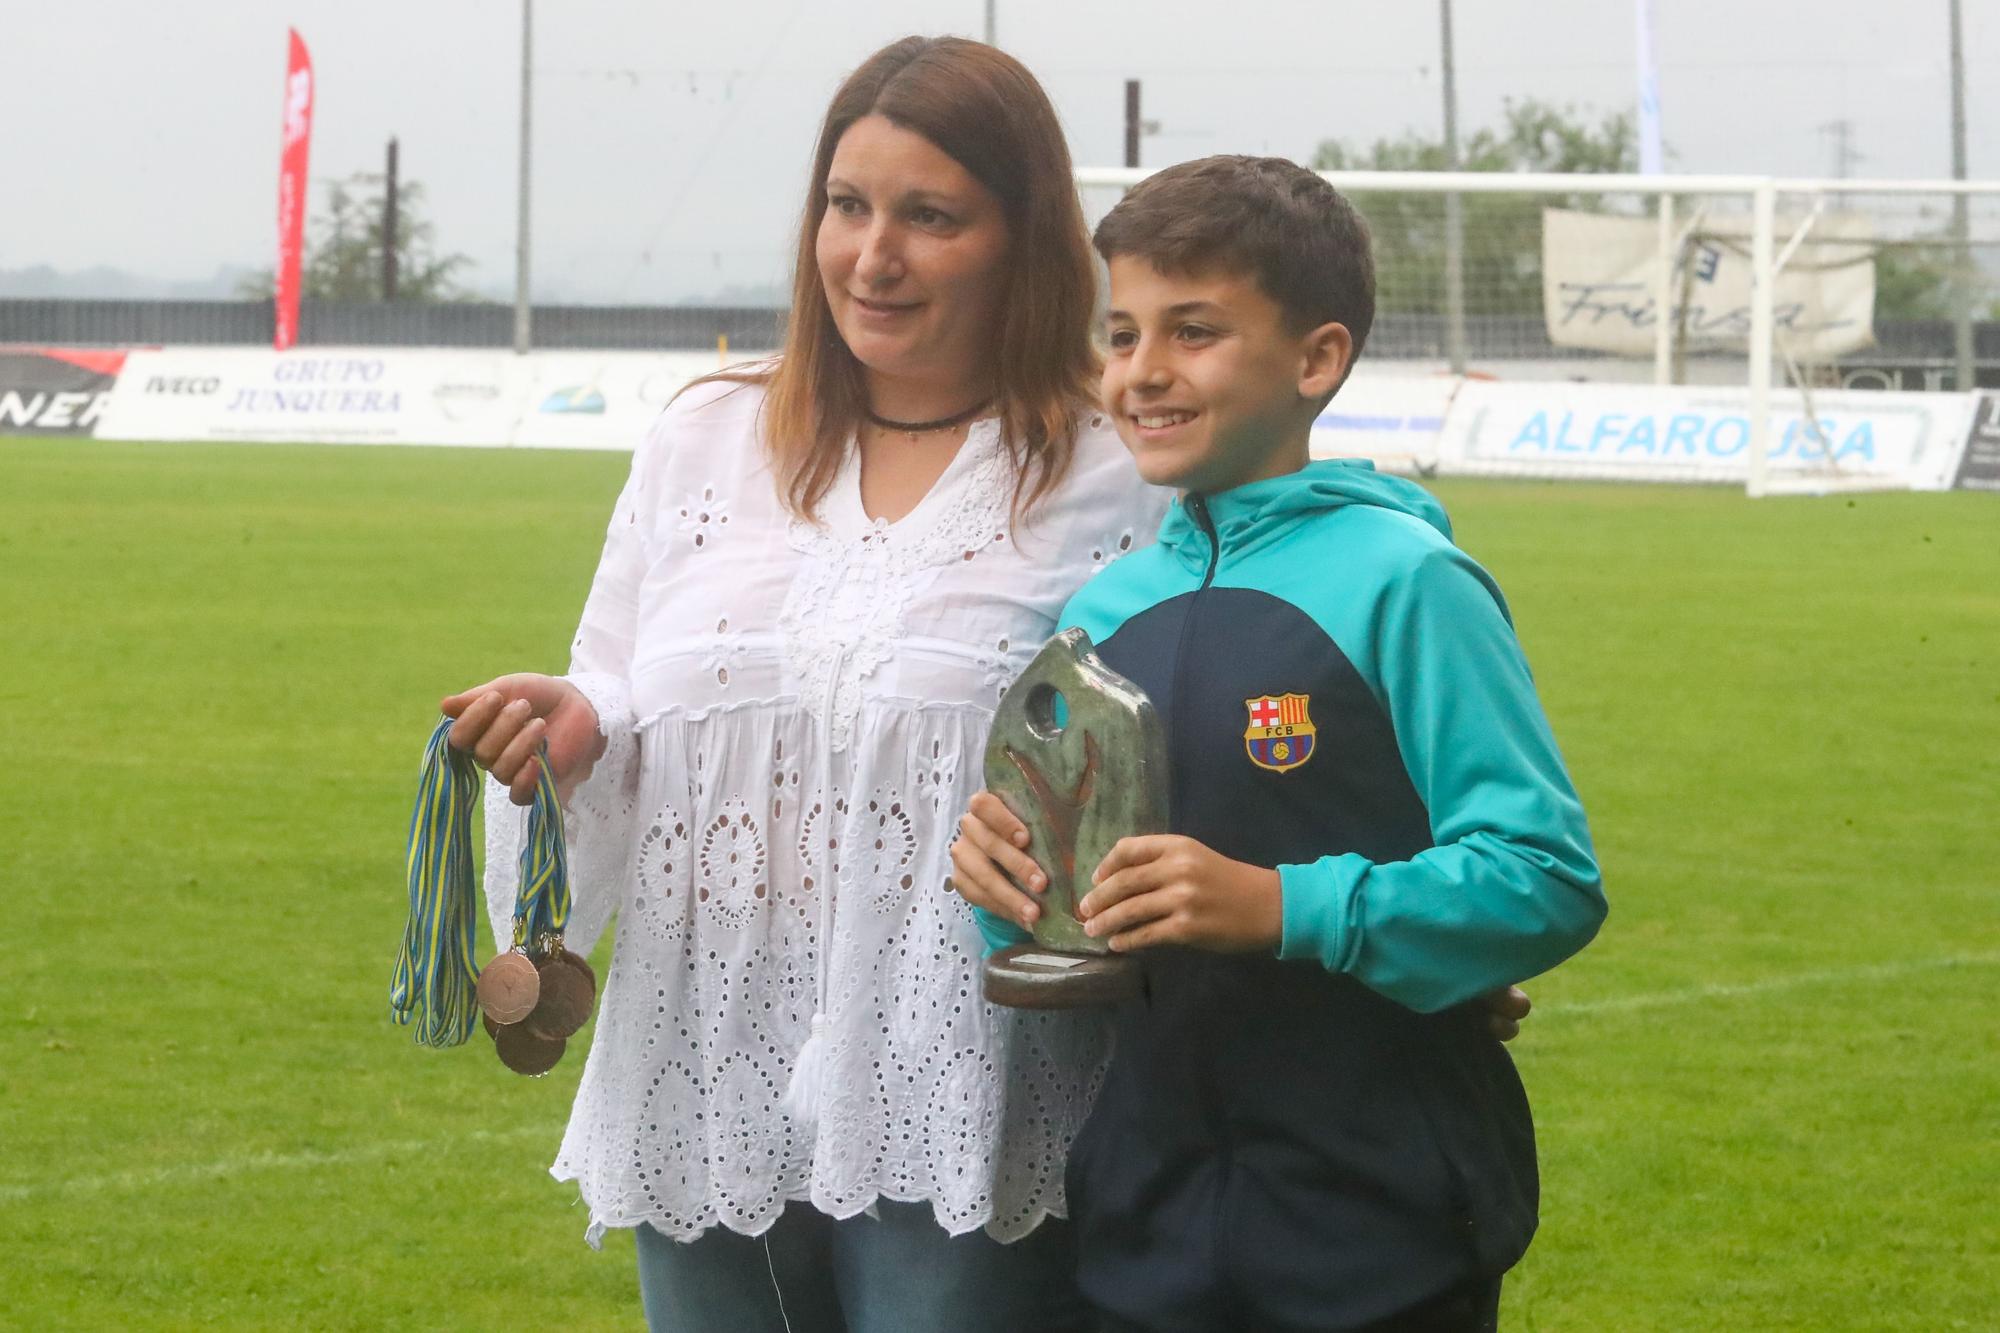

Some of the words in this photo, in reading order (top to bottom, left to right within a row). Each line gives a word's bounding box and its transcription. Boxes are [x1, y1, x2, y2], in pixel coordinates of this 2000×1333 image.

[273, 358, 385, 383] GRUPO
[143, 375, 221, 396] IVECO
[226, 388, 402, 414] JUNQUERA
[1265, 725, 1294, 737] FCB
